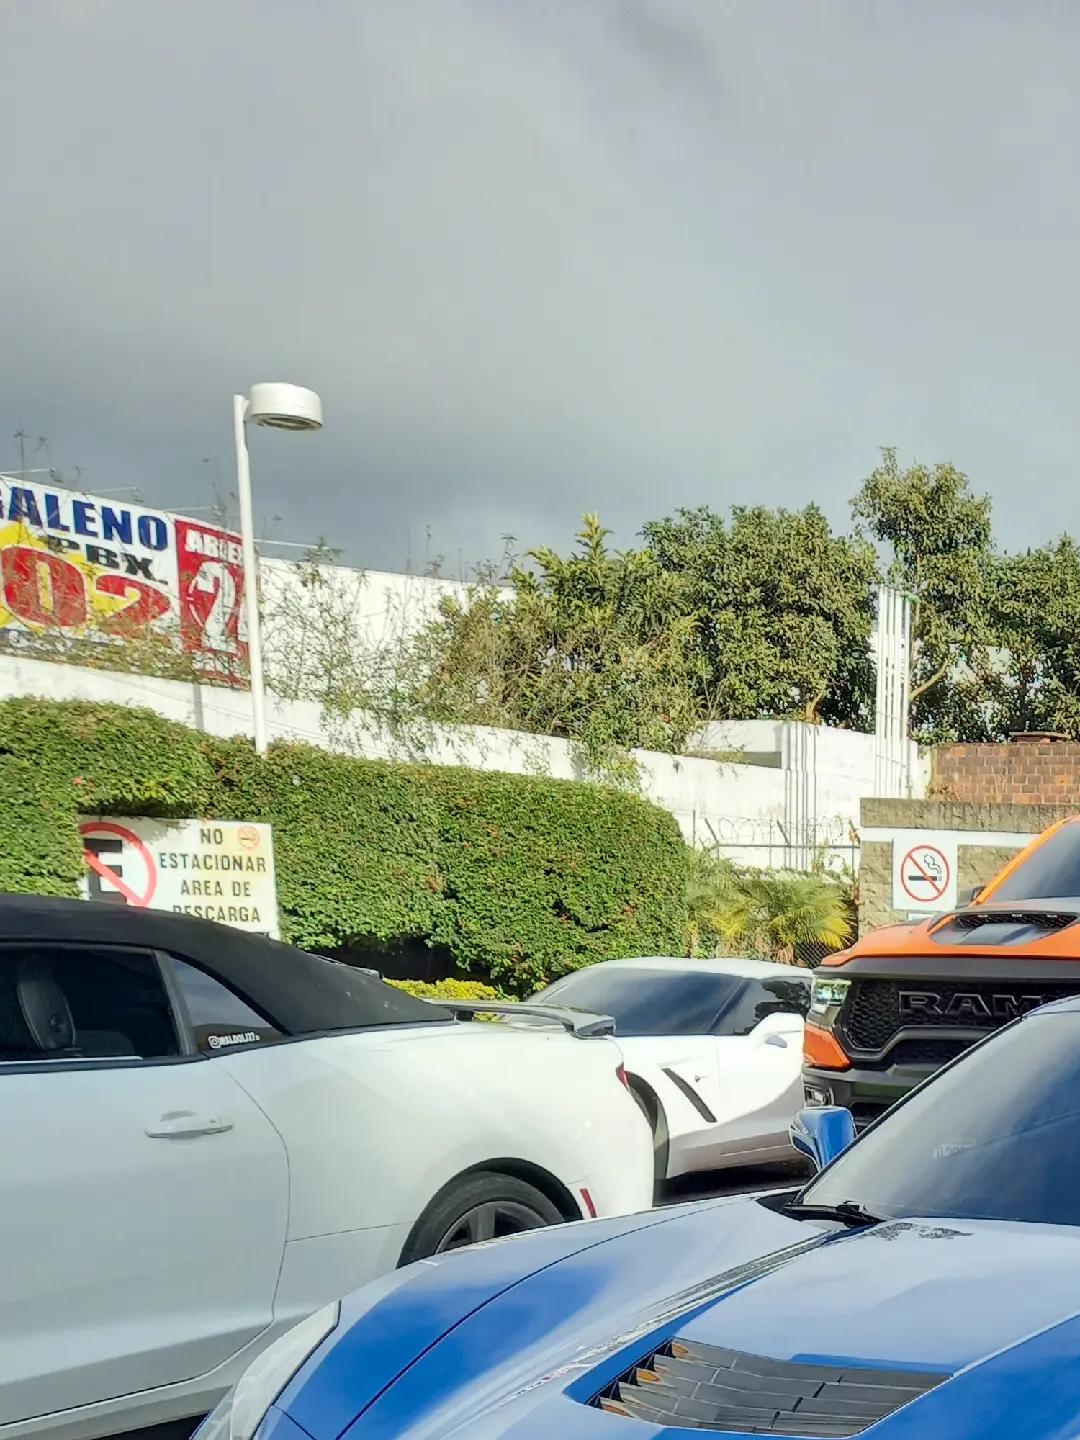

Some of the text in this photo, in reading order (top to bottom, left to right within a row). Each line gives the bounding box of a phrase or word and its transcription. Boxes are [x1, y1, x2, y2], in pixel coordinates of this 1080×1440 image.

[0, 486, 169, 551] ALENO
[200, 827, 223, 845] NO
[160, 852, 267, 873] ESTACIONAR
[180, 879, 251, 897] AREA DE
[899, 990, 1042, 1016] RAM
